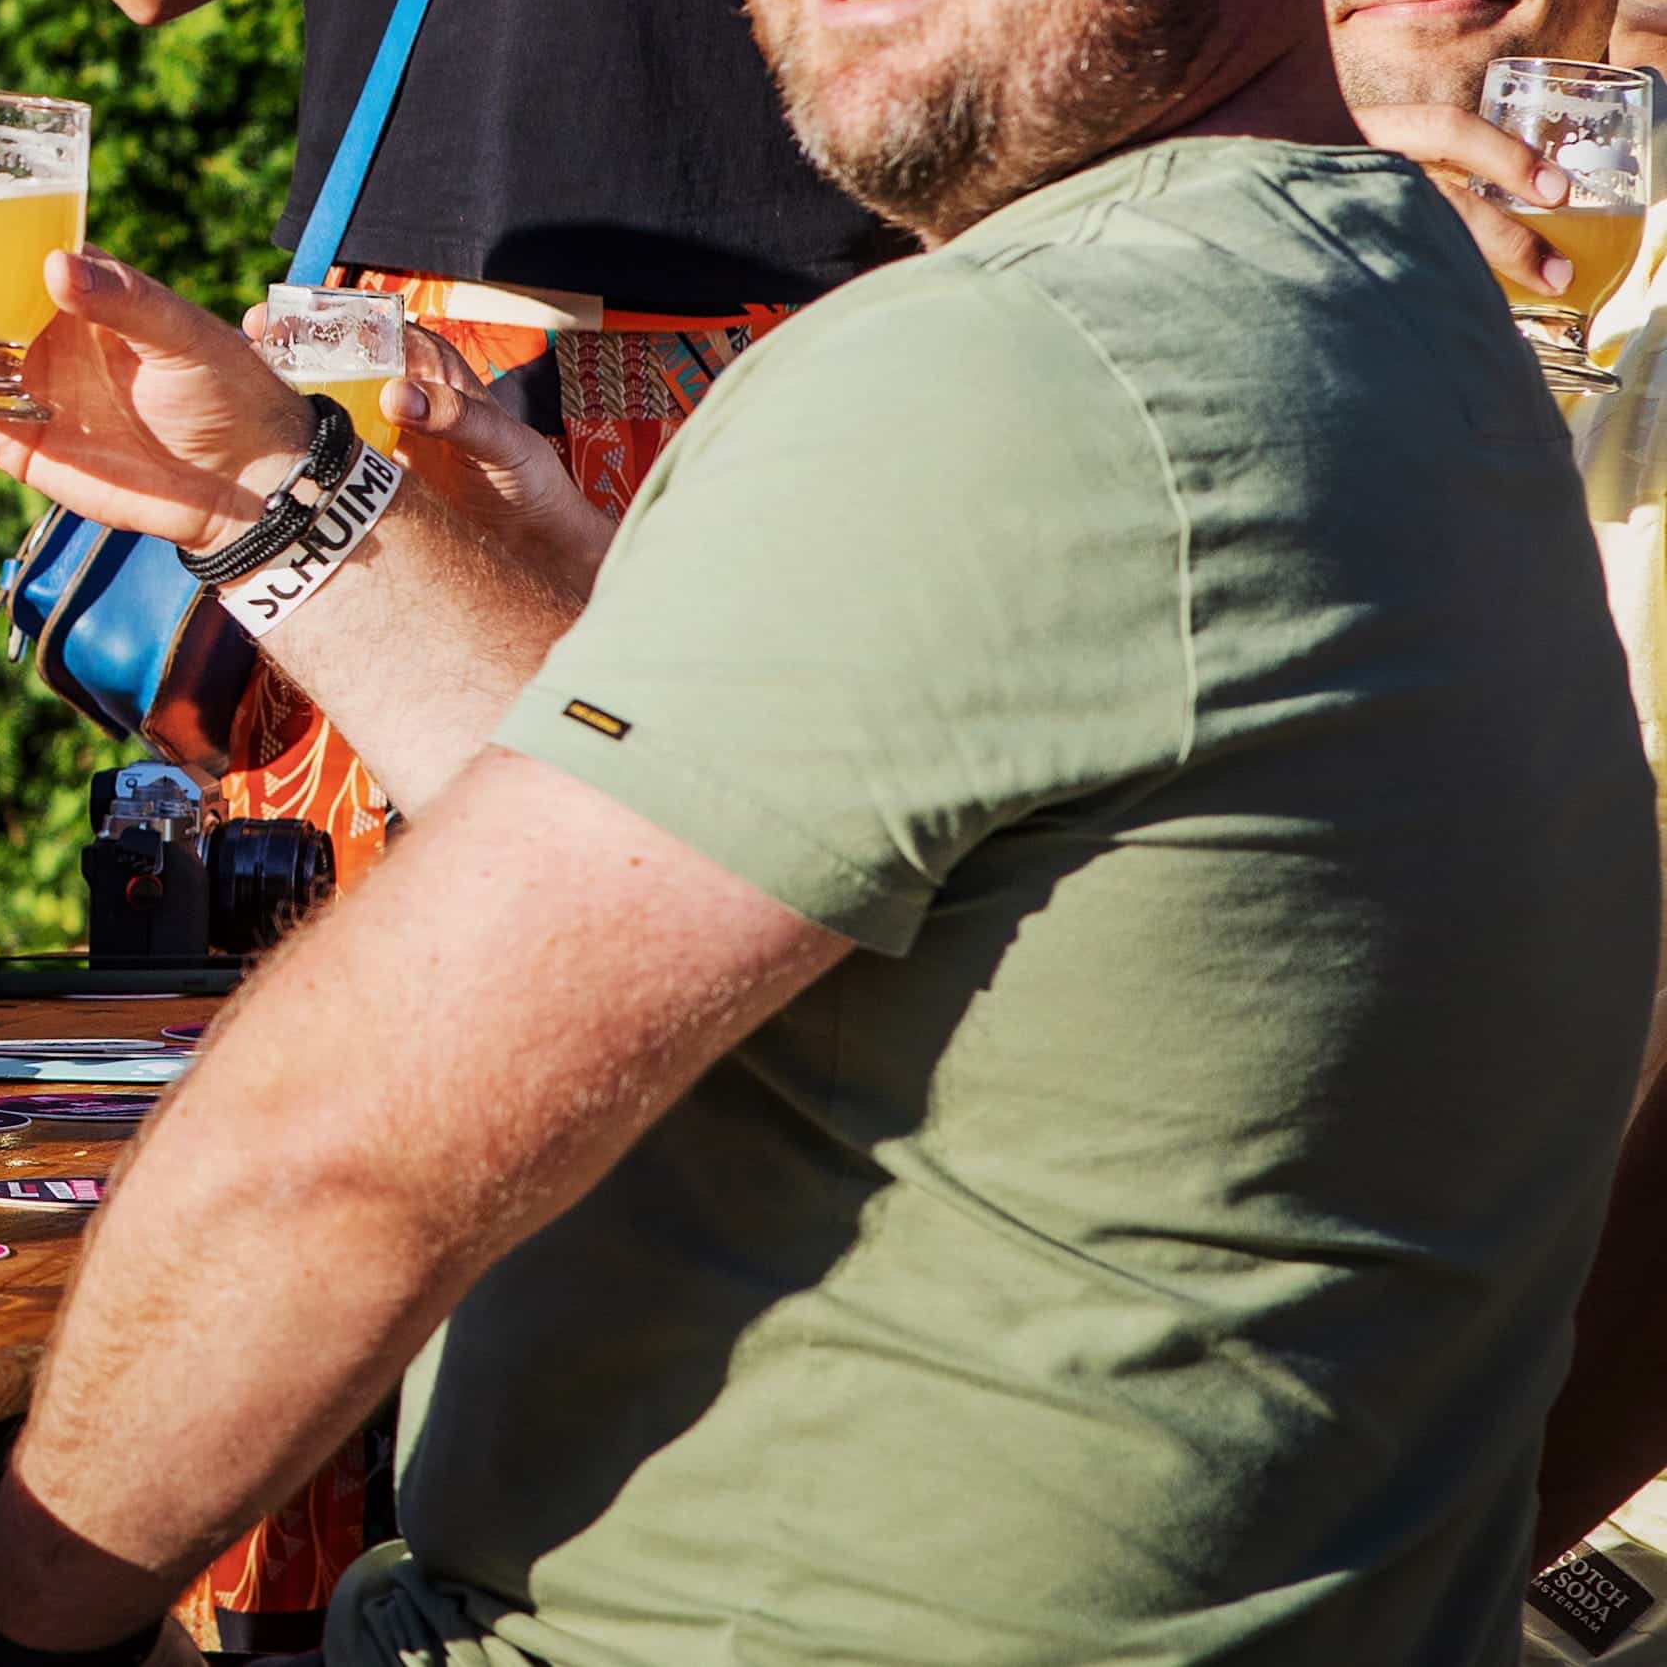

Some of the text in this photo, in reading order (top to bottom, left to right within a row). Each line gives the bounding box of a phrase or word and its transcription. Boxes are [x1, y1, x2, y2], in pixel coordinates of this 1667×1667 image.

[248, 445, 398, 619] SCHUIMB
[1554, 1572, 1611, 1623] SODA
[1556, 1550, 1631, 1609] COTCH
